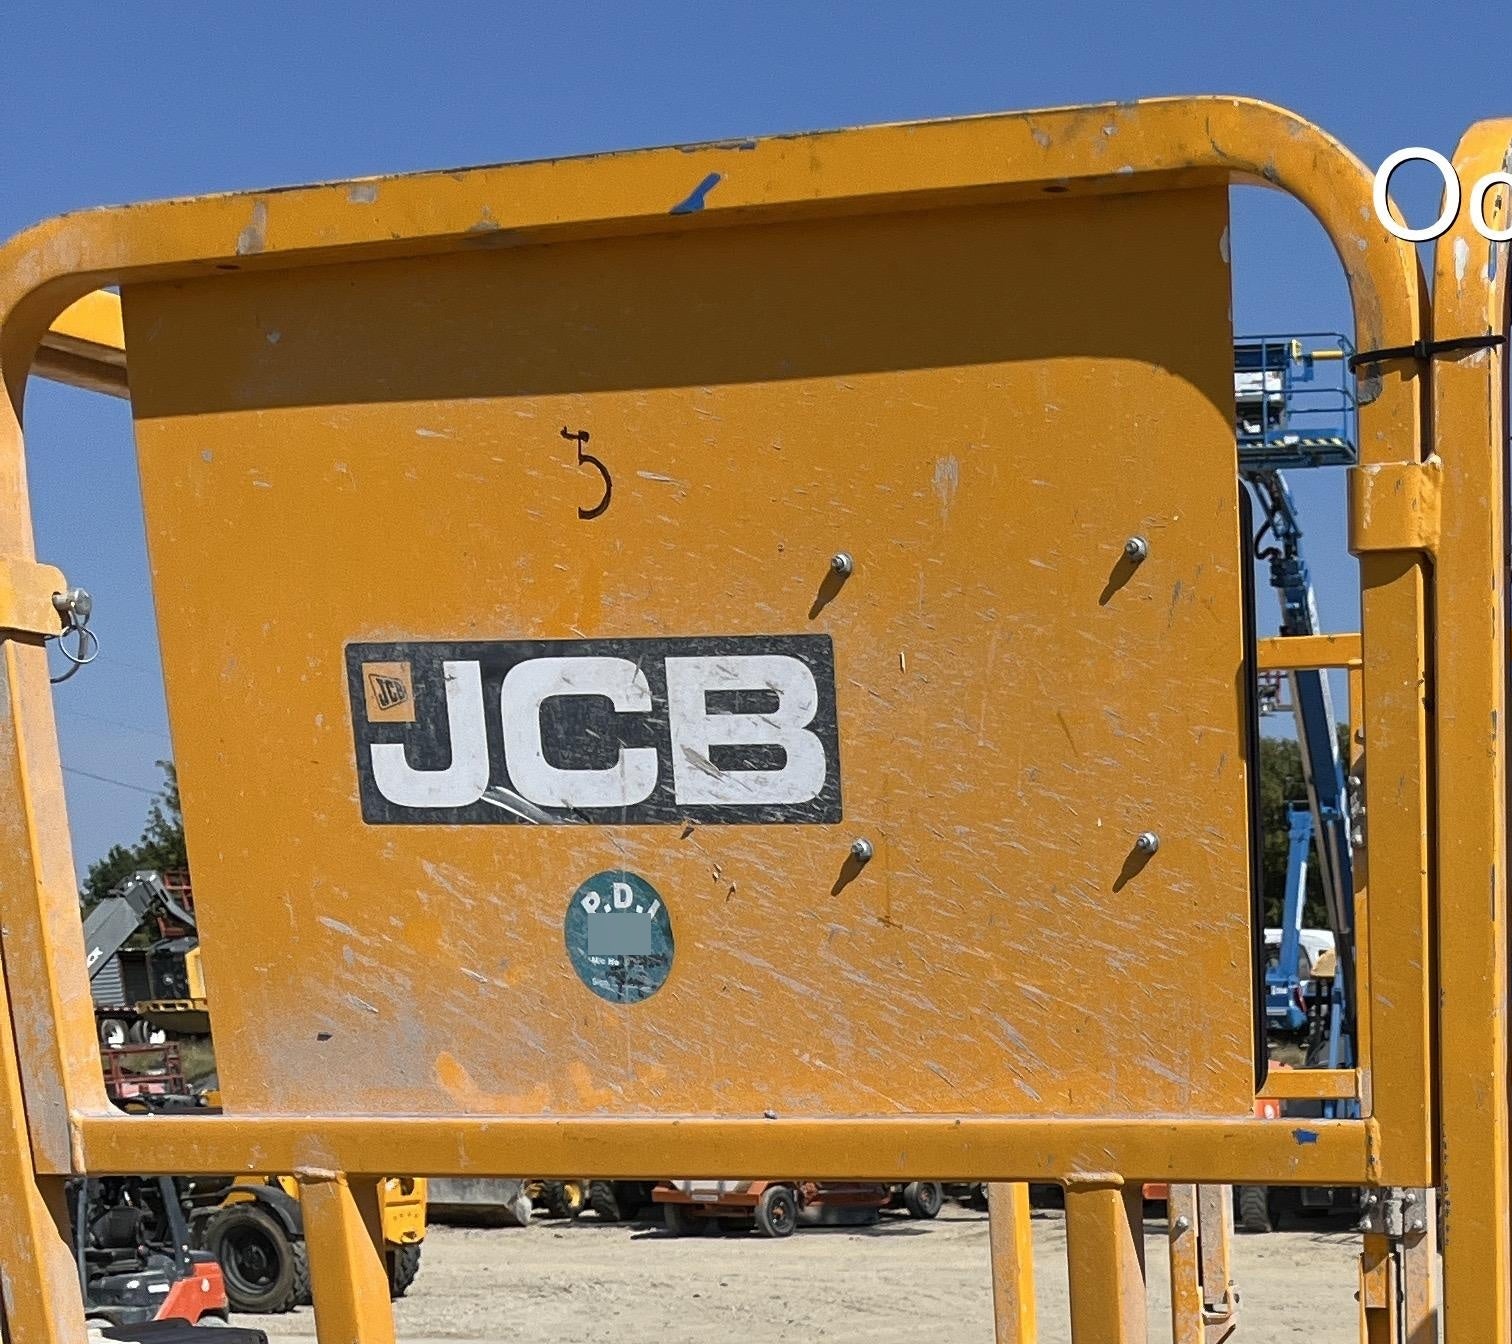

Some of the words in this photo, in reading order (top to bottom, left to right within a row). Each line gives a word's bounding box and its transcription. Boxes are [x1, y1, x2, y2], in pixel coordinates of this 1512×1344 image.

[561, 425, 613, 520] 5
[370, 655, 827, 808] JCB
[376, 677, 407, 706] JCB
